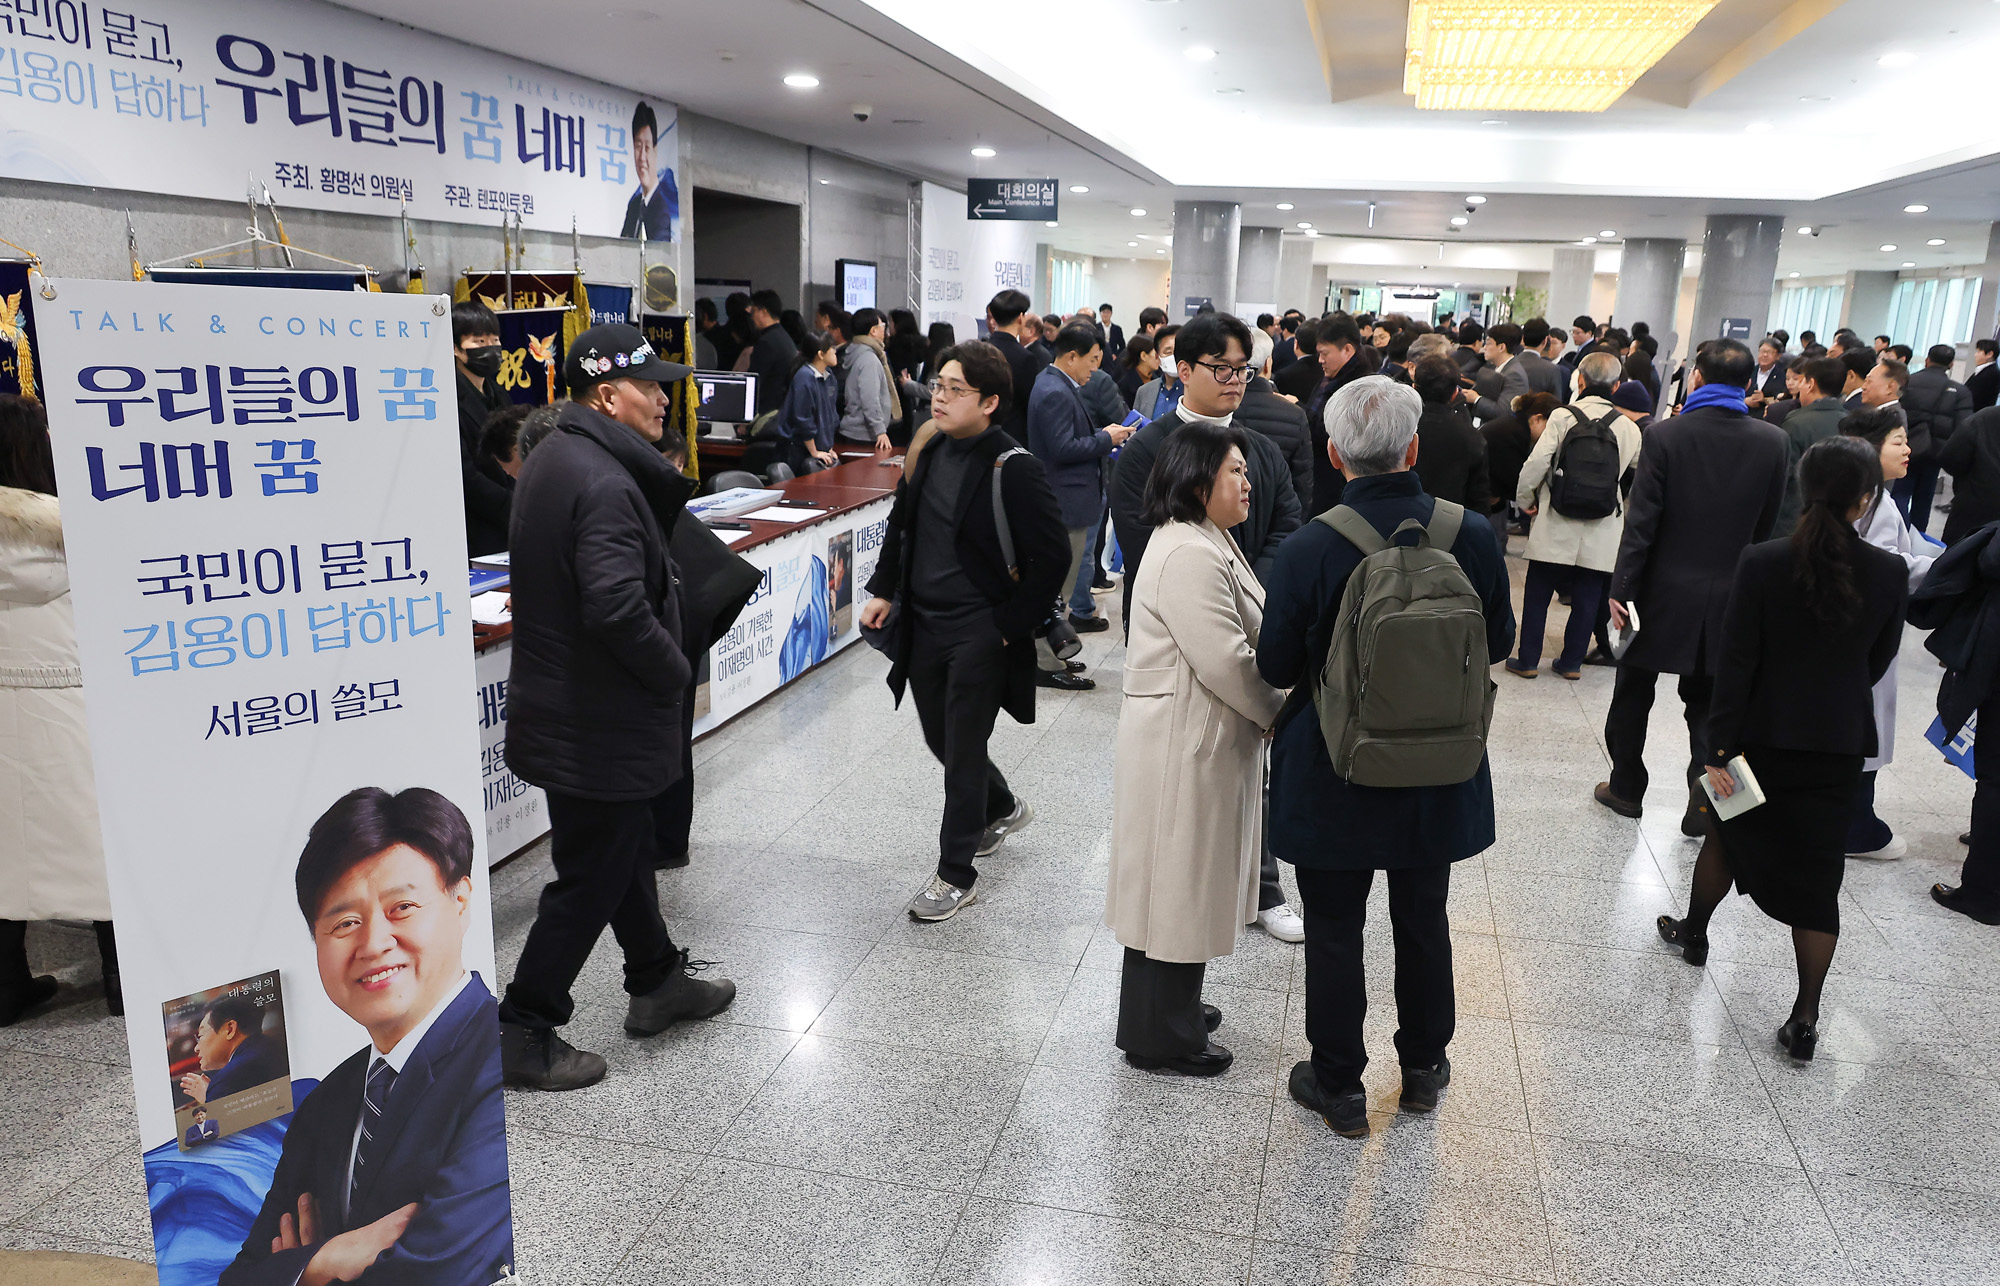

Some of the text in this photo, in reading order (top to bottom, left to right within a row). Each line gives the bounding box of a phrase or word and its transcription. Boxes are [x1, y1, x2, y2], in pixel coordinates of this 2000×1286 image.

[102, 8, 183, 72] 묻고,
[109, 68, 210, 127] 답하다
[214, 34, 628, 185] 우리들의 꿈 너머 꿈
[508, 74, 542, 97] TALK
[568, 91, 627, 119] CONCERT
[275, 161, 413, 202] 주최. 황명선 의원실
[445, 184, 474, 208] 주관.
[997, 182, 1055, 200] 대회의실
[1004, 199, 1041, 207] Conference
[1042, 199, 1055, 207] Hall
[994, 260, 1023, 289] 우리들의
[69, 309, 432, 340] TALK & CONCERT
[496, 347, 532, 392] 祝
[74, 363, 440, 427] 우리들의 꿈
[84, 438, 322, 502] 너머 꿈
[137, 537, 430, 605] 국민이 묻고,
[776, 556, 801, 593] 쓸모
[122, 591, 452, 677] 김용이 답하다
[747, 608, 773, 638] 기록한
[717, 633, 774, 682] 이재명의 시간
[204, 678, 404, 741] 서울의 쓸모
[228, 976, 275, 999] 대통령의
[253, 992, 277, 1008] 쓸모
